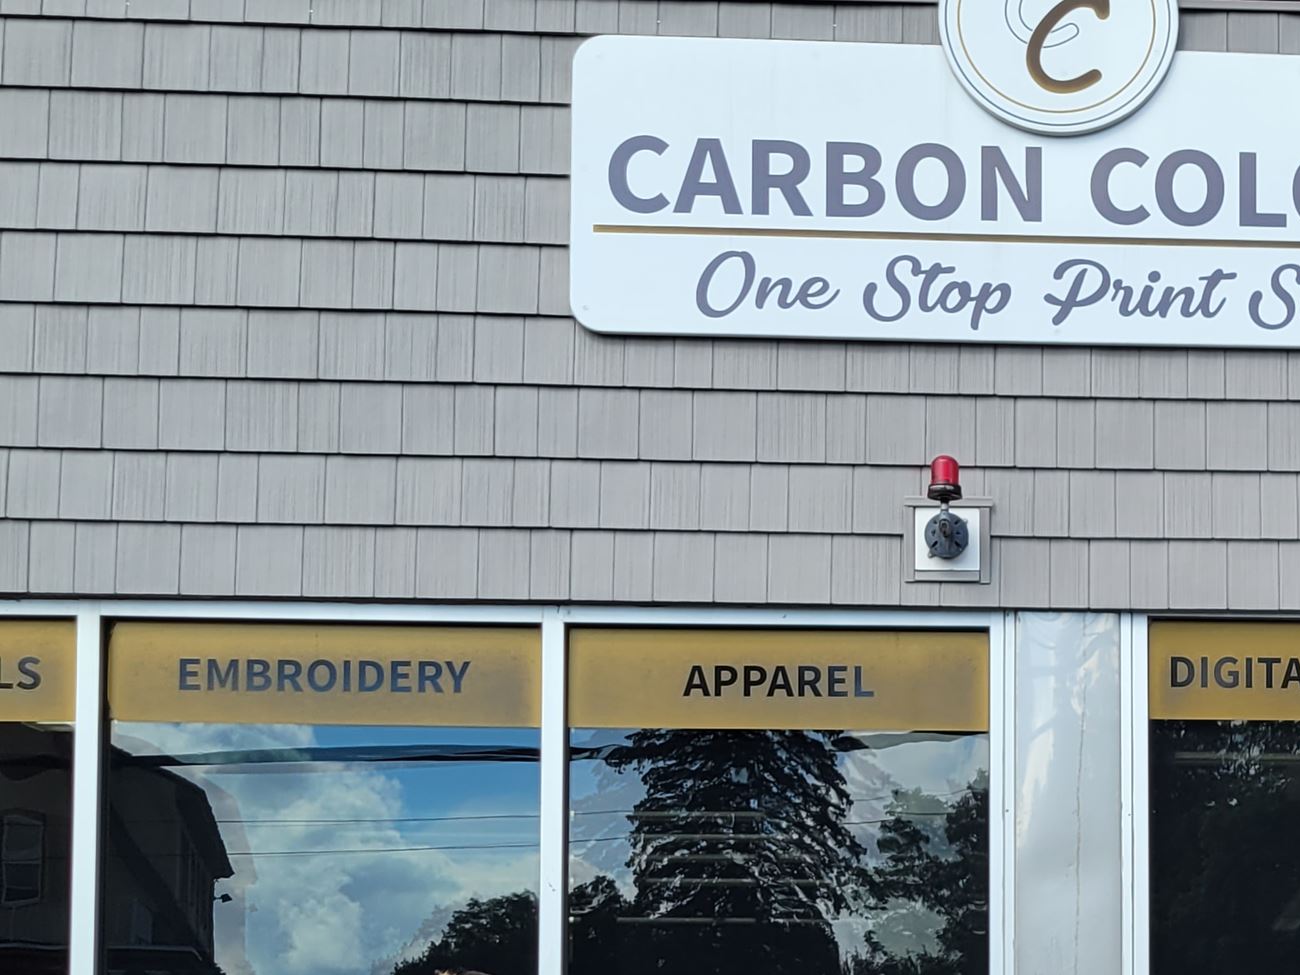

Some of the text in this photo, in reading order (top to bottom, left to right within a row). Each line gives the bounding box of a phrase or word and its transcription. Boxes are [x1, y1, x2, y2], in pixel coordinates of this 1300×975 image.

[607, 134, 1043, 224] CARBON
[695, 250, 841, 319] One
[862, 254, 1012, 331] Stop
[1043, 258, 1238, 326] Print
[178, 658, 472, 694] EMBROIDERY
[682, 664, 875, 698] APPAREL
